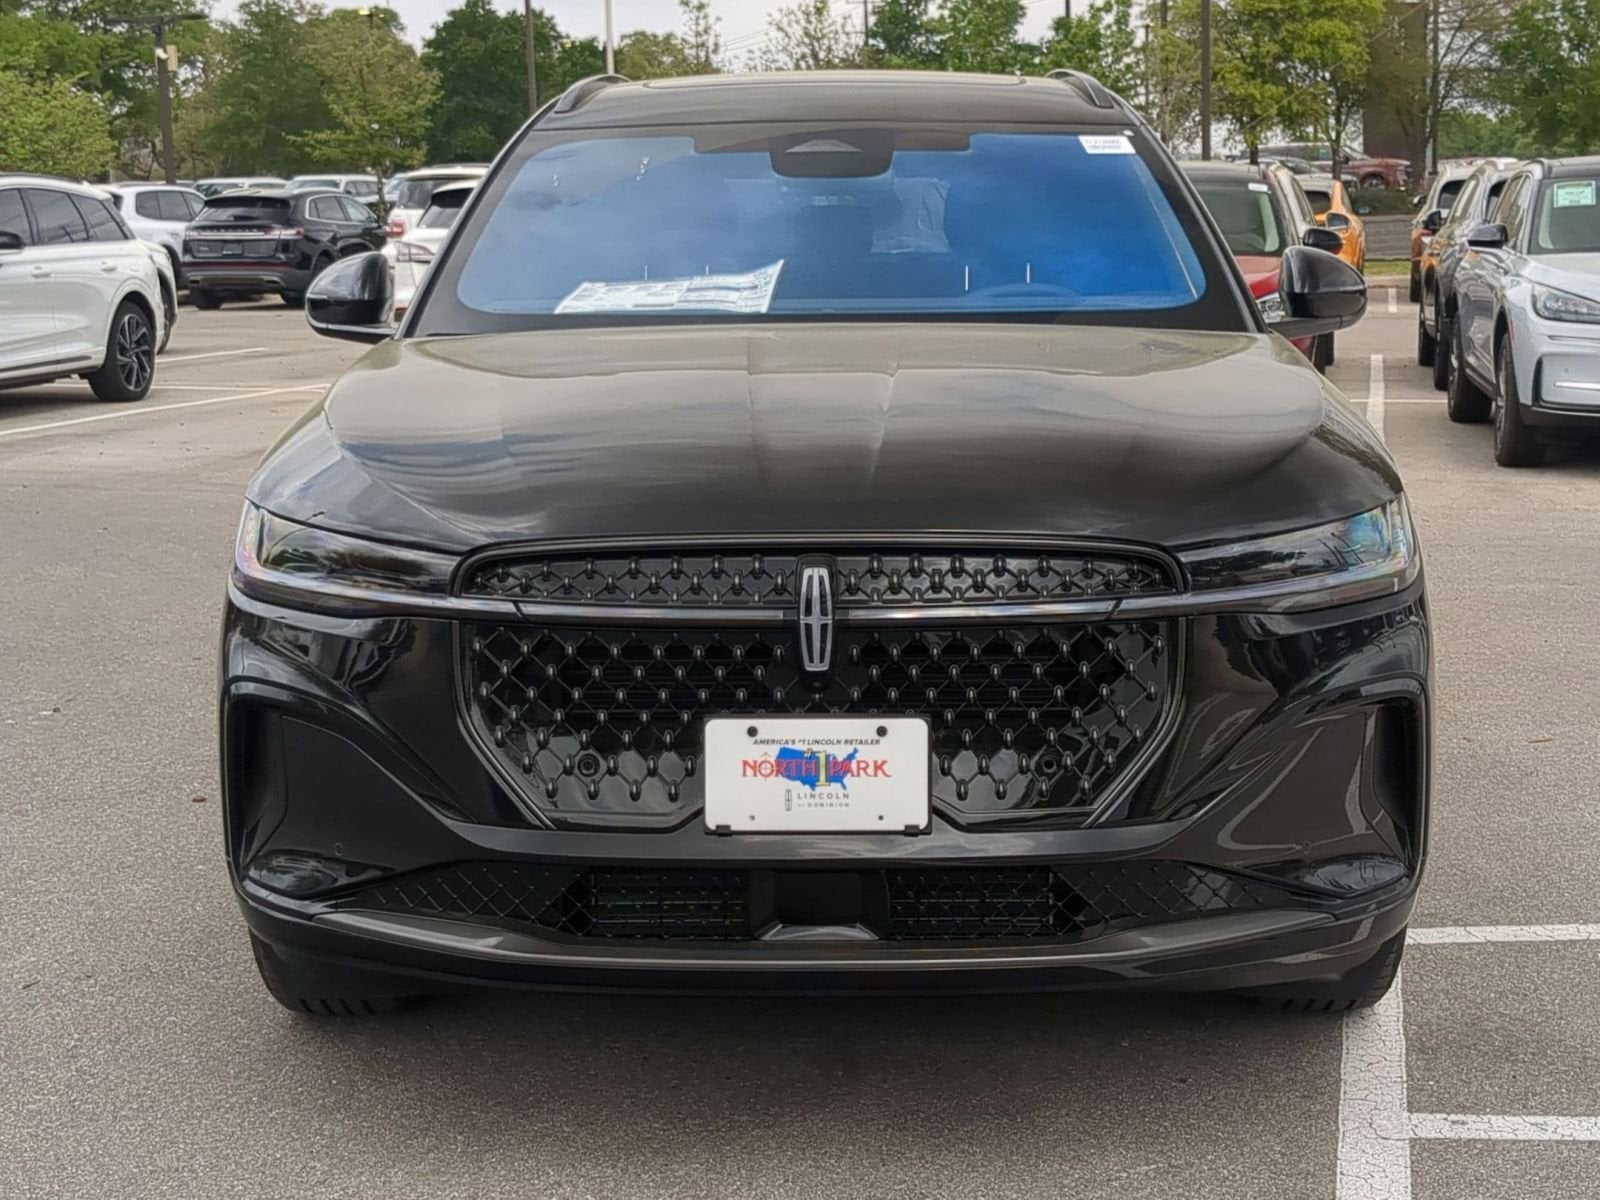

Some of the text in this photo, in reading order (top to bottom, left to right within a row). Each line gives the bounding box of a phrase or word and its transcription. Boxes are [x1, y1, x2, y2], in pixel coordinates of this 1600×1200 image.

[742, 760, 892, 778] NORTH PARK
[797, 792, 850, 800] LINCOLN
